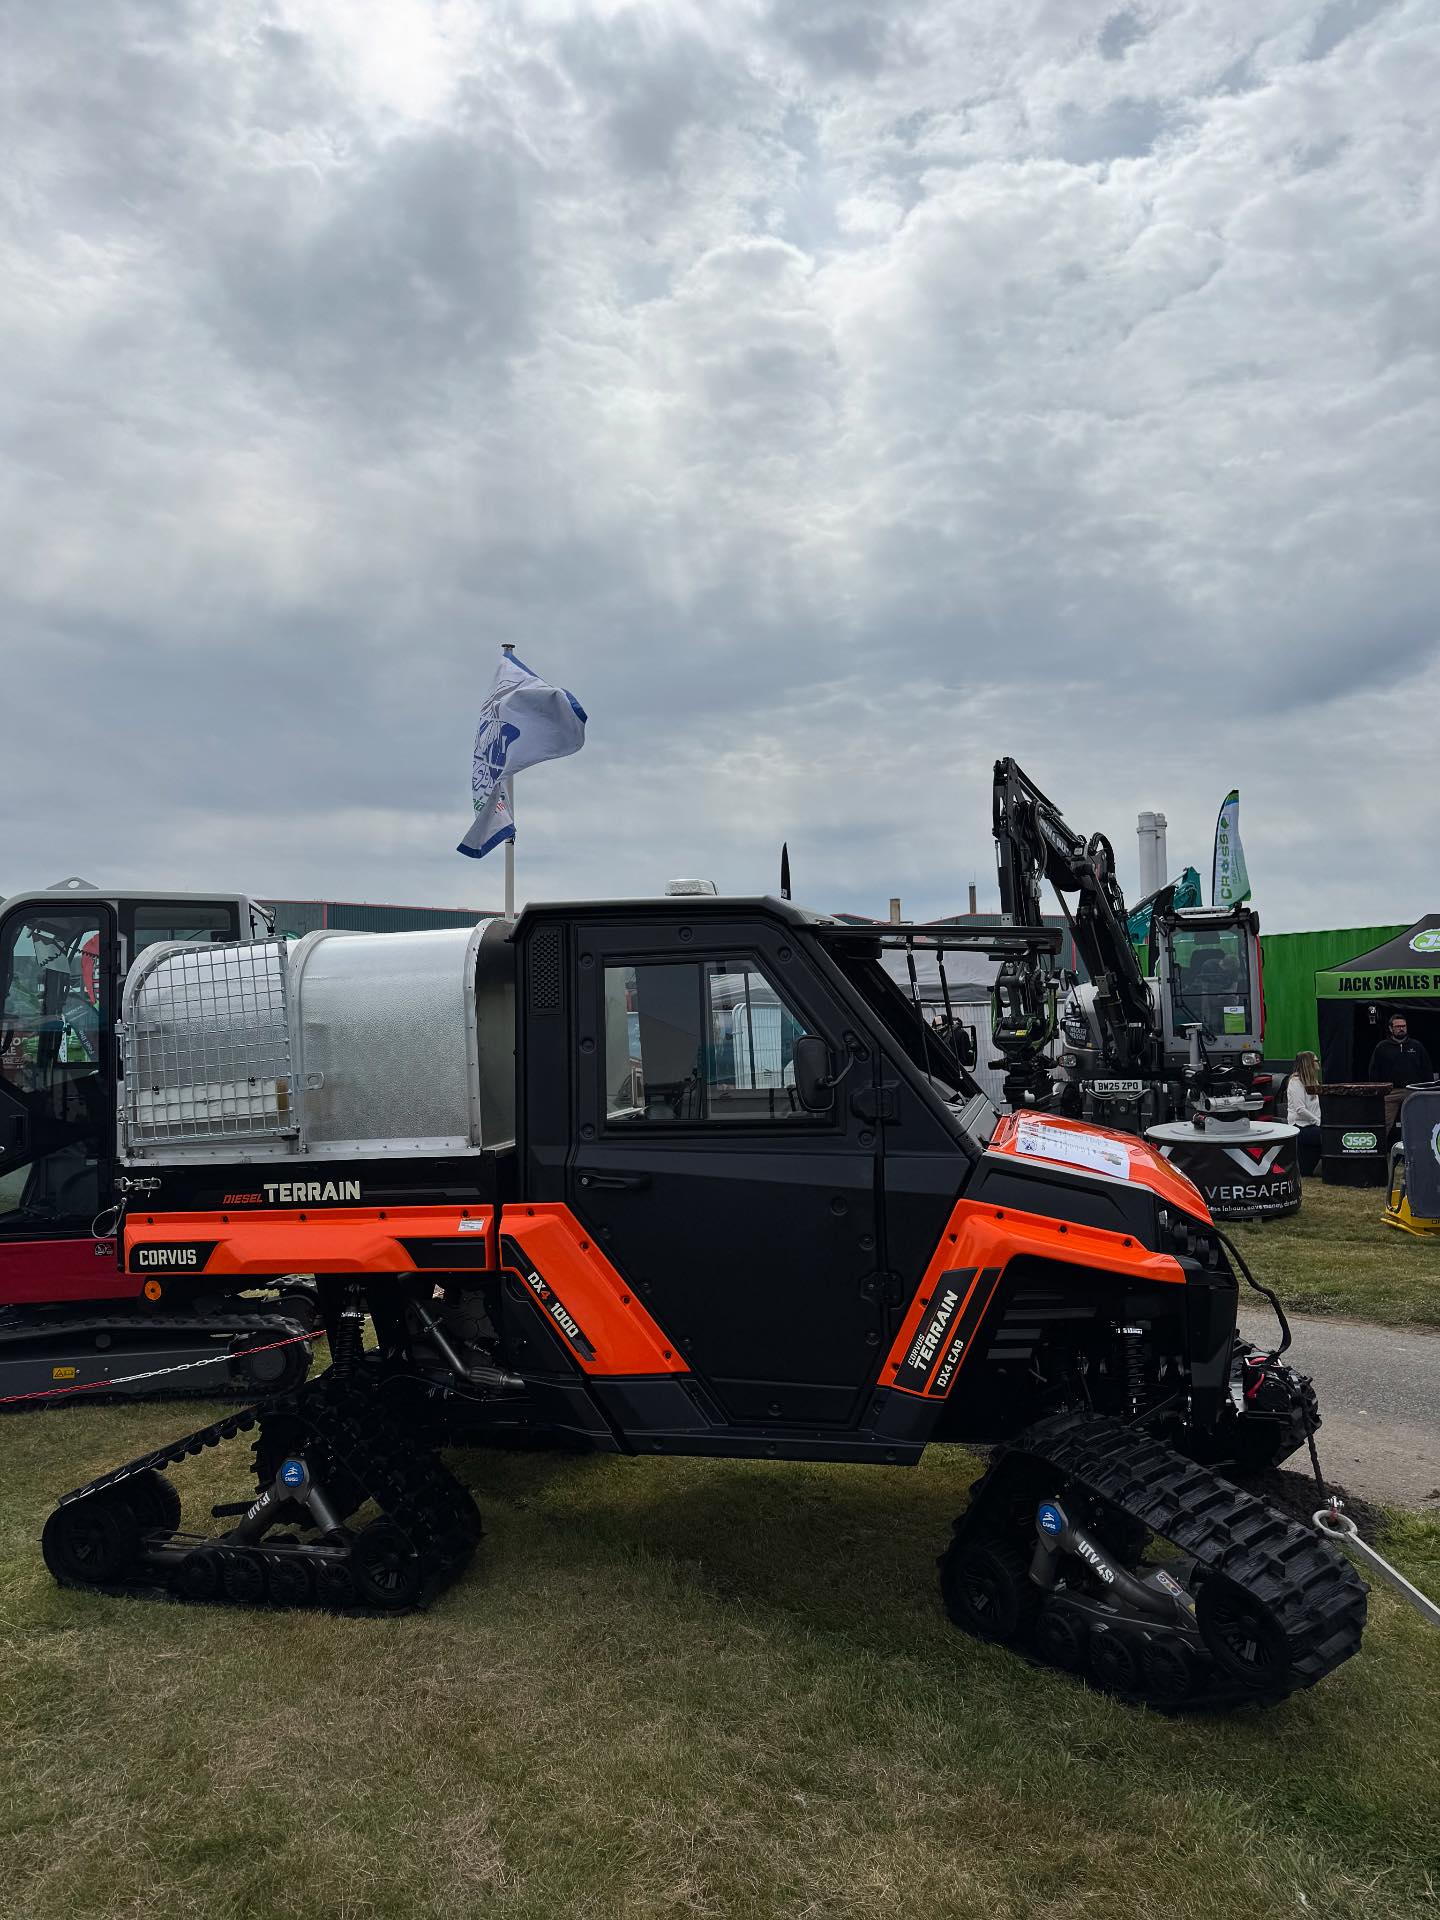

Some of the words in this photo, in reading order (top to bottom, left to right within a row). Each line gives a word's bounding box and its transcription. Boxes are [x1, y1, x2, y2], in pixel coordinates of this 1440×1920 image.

[1338, 976, 1371, 991] JACK
[1374, 975, 1430, 990] SWALES
[1098, 1082, 1120, 1091] BW25
[1346, 1136, 1373, 1146] JSPS
[223, 1193, 263, 1204] DIESEL
[263, 1180, 361, 1203] TERRAIN
[139, 1249, 197, 1266] CORVUS
[527, 1271, 550, 1300] DX4
[550, 1302, 579, 1338] 1000
[913, 1289, 959, 1371] TERRAIN
[907, 1333, 925, 1366] CORVUS
[937, 1364, 953, 1388] DX4
[947, 1339, 964, 1364] CAB
[247, 1500, 261, 1520] UTV
[1078, 1540, 1100, 1565] UTV
